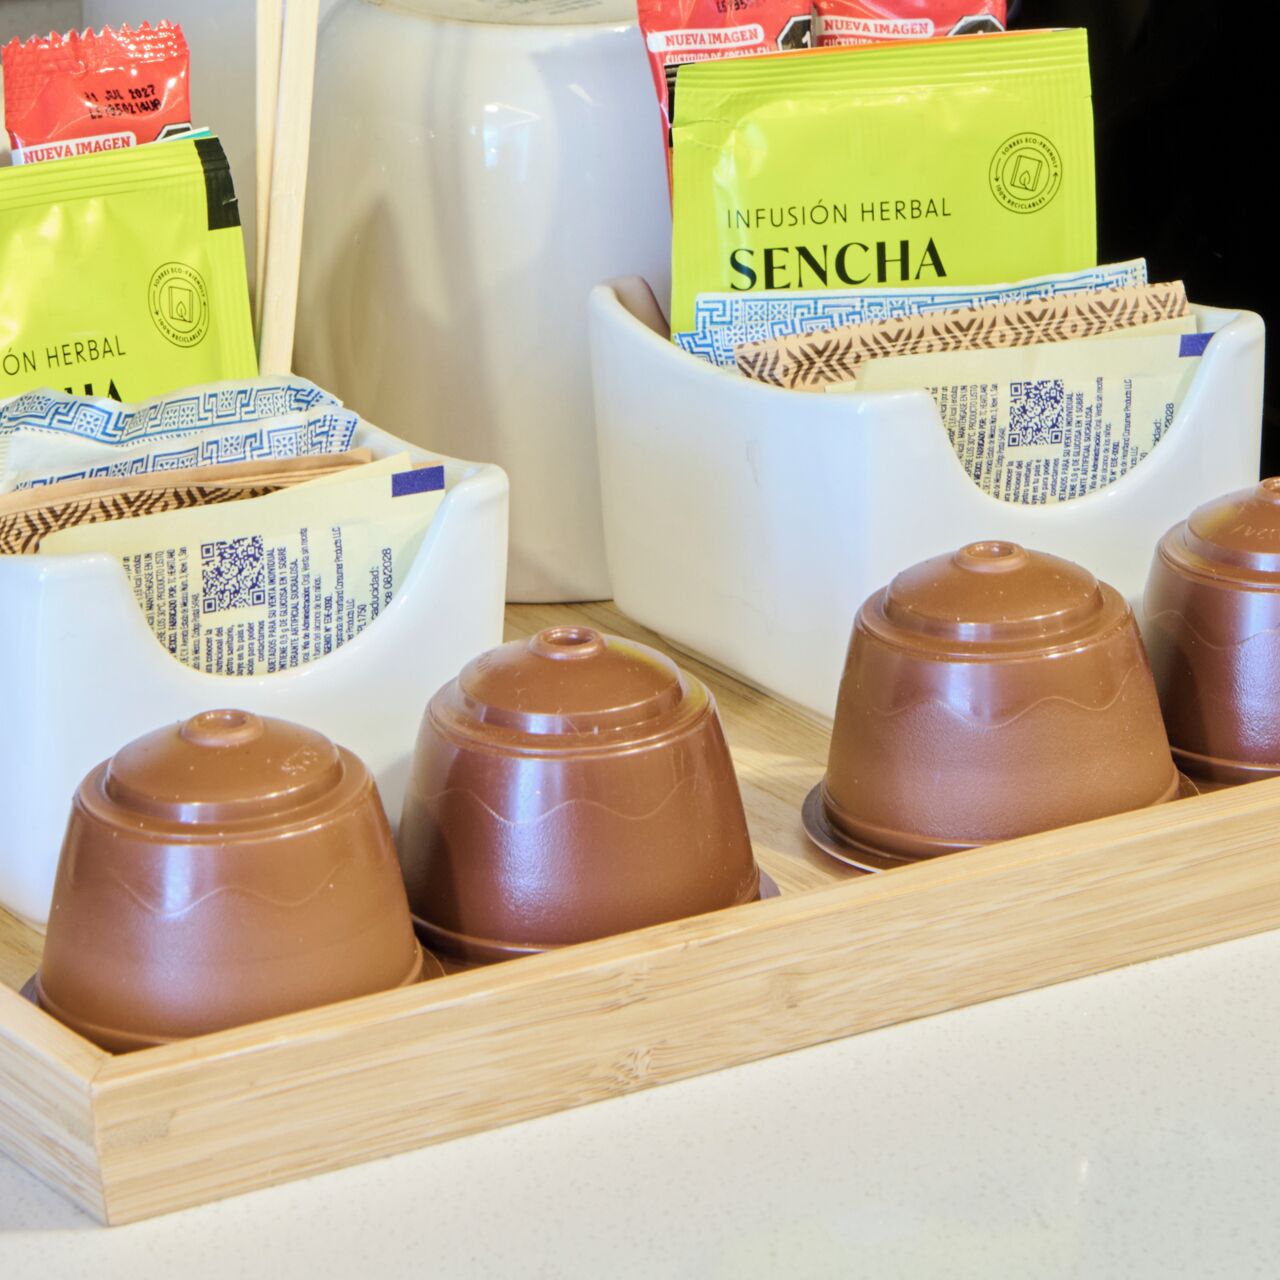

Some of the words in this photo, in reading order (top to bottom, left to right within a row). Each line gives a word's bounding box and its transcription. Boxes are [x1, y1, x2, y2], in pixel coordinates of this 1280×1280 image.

[664, 34, 705, 47] NUEVA
[708, 28, 759, 45] IMAGEN
[824, 19, 872, 32] NUEVA
[874, 22, 929, 35] IMAGEN
[23, 145, 73, 164] NUEVA
[75, 136, 132, 156] IMAGEN
[727, 198, 848, 229] INFUSIÓN
[861, 197, 952, 222] HERBAL
[729, 237, 947, 292] SENCHA
[46, 335, 126, 369] HERBAL
[1059, 476, 1068, 501] ETADOS
[1065, 392, 1073, 426] INDIVIDUAL
[1080, 444, 1090, 475] ARTIFICIAL
[1068, 484, 1077, 499] TIENE
[1078, 477, 1087, 496] RANTE
[266, 548, 275, 585] INDIVIDUAL
[277, 547, 286, 569] SOBRE
[267, 587, 276, 607] VENTA
[278, 587, 287, 616] GLUCOSA
[268, 620, 276, 638] PARA
[290, 602, 299, 636] ARTIFICIAL
[279, 646, 287, 670] NTIENE
